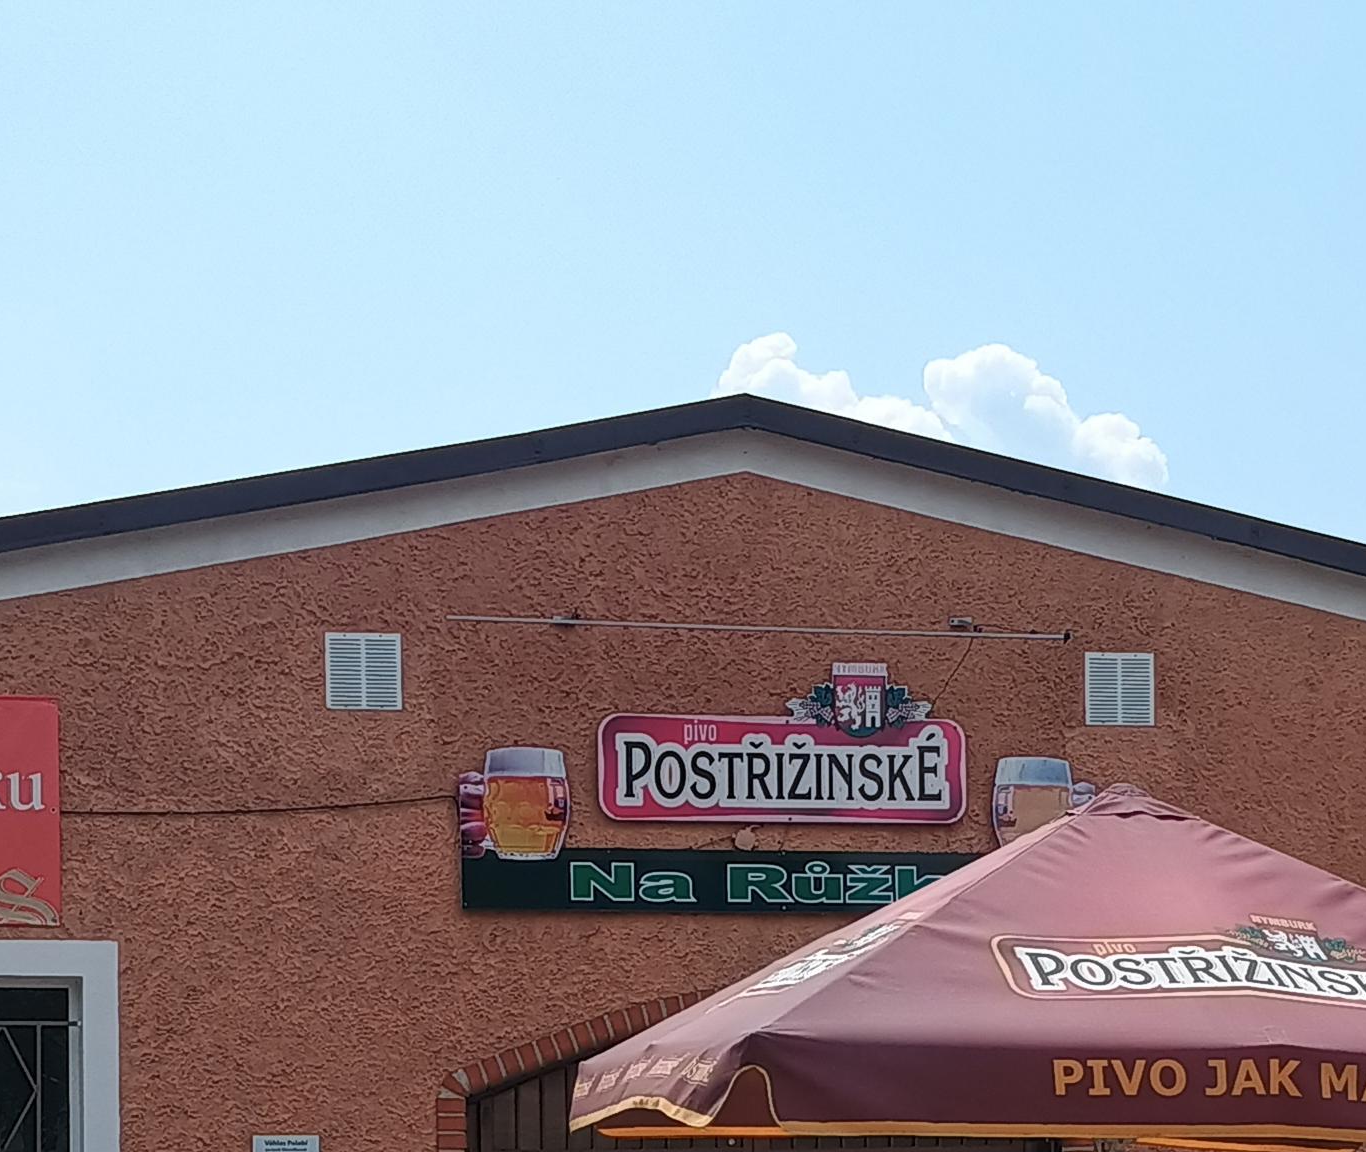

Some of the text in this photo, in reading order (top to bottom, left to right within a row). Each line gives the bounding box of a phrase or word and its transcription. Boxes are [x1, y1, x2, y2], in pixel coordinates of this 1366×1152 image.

[683, 720, 717, 745] pivo
[623, 732, 943, 801] POSTŘIŽINSKÉ
[570, 861, 945, 903] Na Růžk
[1092, 941, 1137, 956] pivo
[1052, 1059, 1187, 1096] PIVO
[1205, 1059, 1303, 1098] JAK
